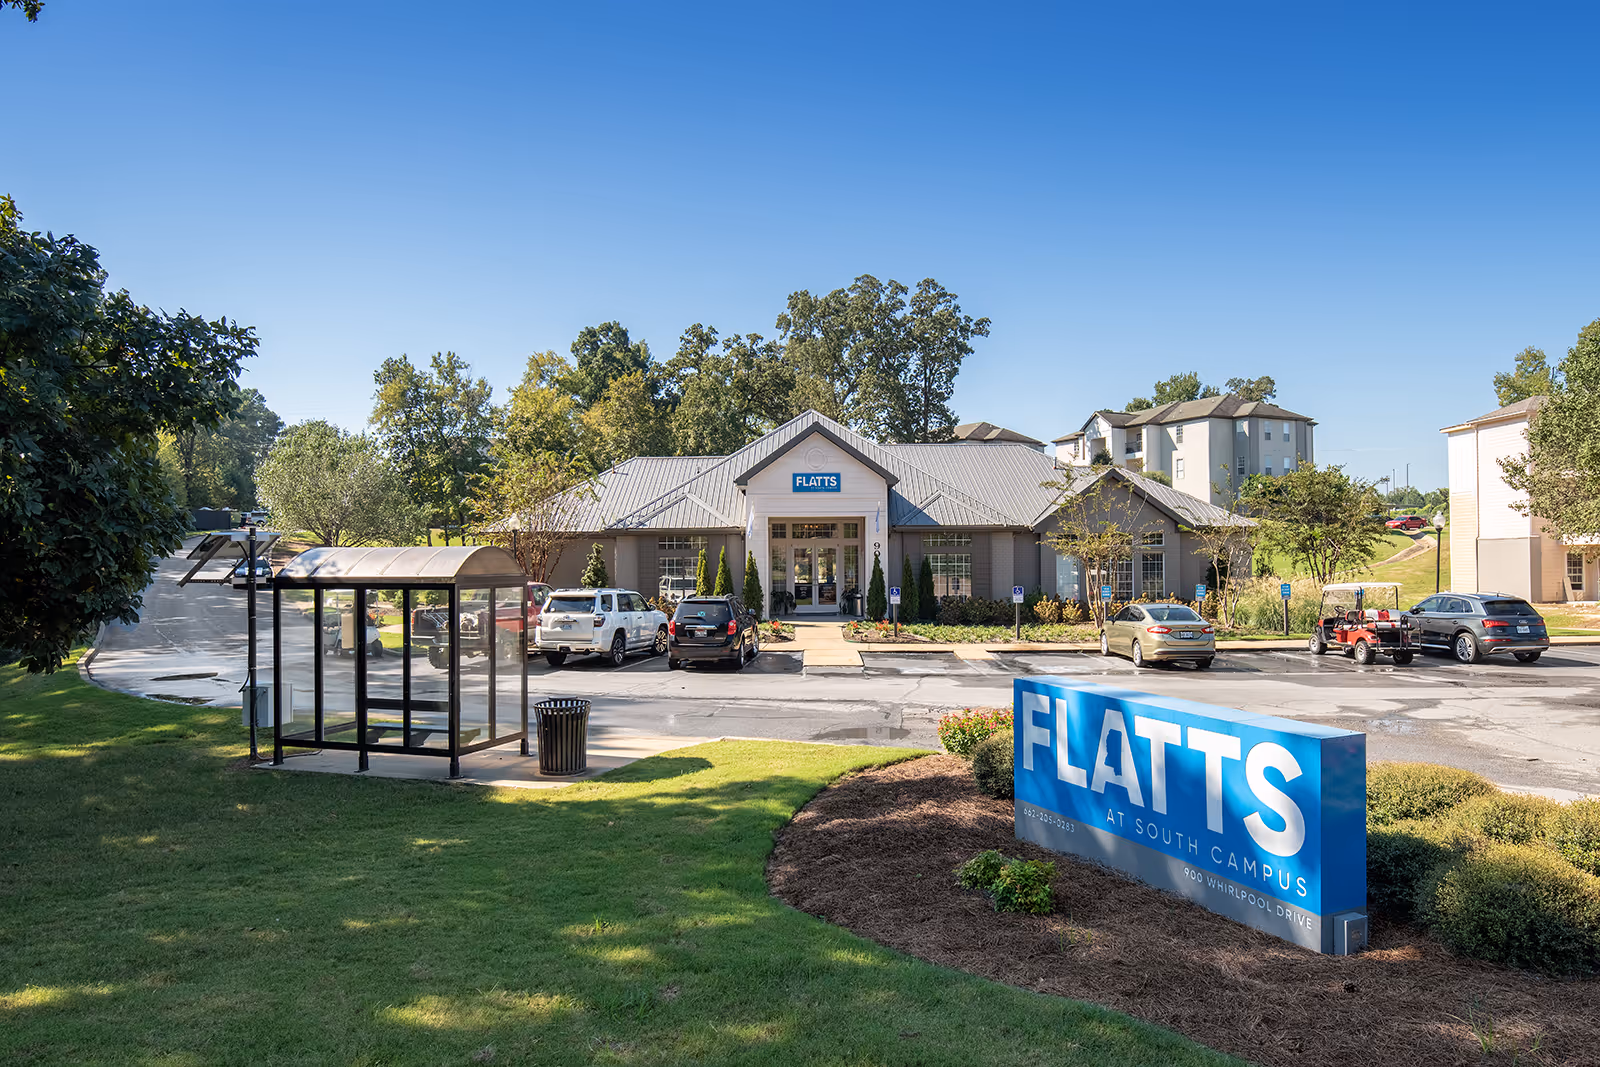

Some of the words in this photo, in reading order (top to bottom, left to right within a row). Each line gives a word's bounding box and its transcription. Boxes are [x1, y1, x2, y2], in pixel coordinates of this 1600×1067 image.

[796, 476, 836, 486] FLATTS
[1022, 690, 1305, 857] FLATTS
[1023, 807, 1075, 833] 662-205-0283
[1106, 808, 1125, 827] AT
[1135, 818, 1199, 856] SOUTH
[1211, 846, 1308, 898] CAMPUS
[1183, 867, 1203, 883] 900
[1206, 876, 1273, 913] WHIRLPOOL
[1276, 905, 1313, 930] DRIVE
